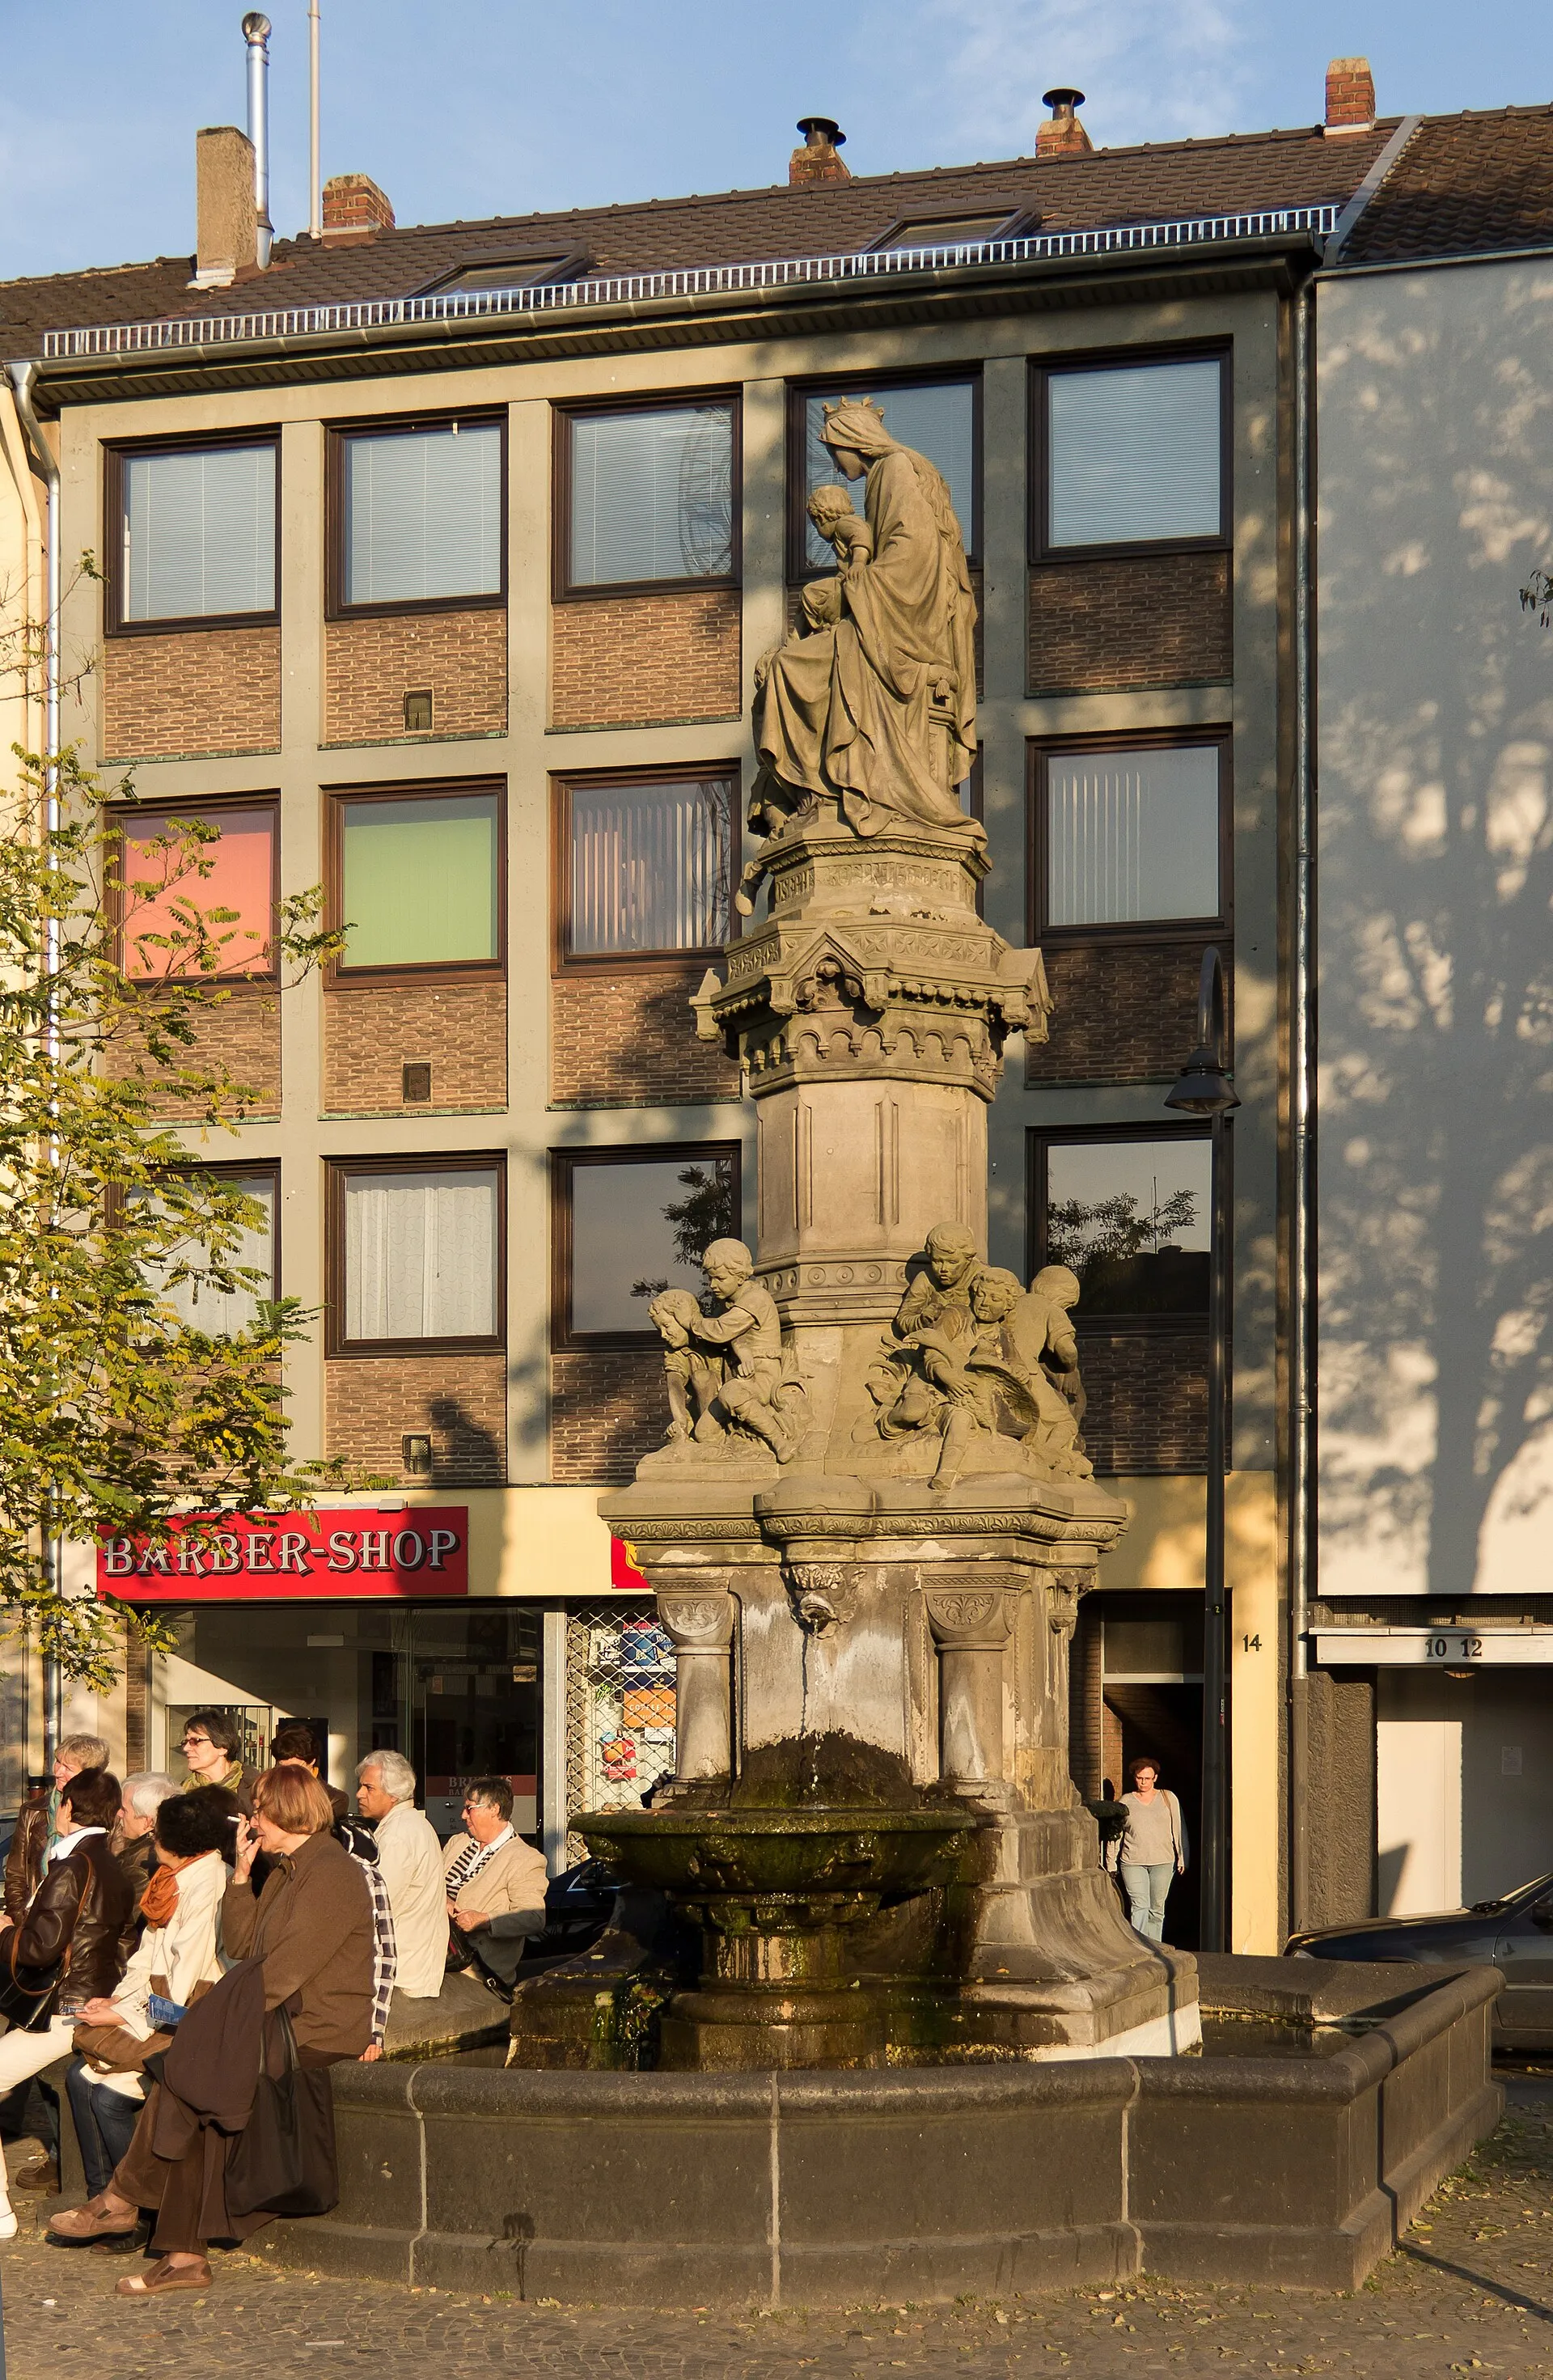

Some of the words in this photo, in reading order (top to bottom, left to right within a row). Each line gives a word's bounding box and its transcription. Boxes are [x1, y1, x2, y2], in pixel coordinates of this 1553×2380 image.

[105, 1530, 459, 1577] BARBER-SHOP
[1215, 1605, 1221, 1614] 2
[1242, 1633, 1263, 1653] 14
[1425, 1638, 1447, 1658] 10
[1460, 1638, 1483, 1658] 12
